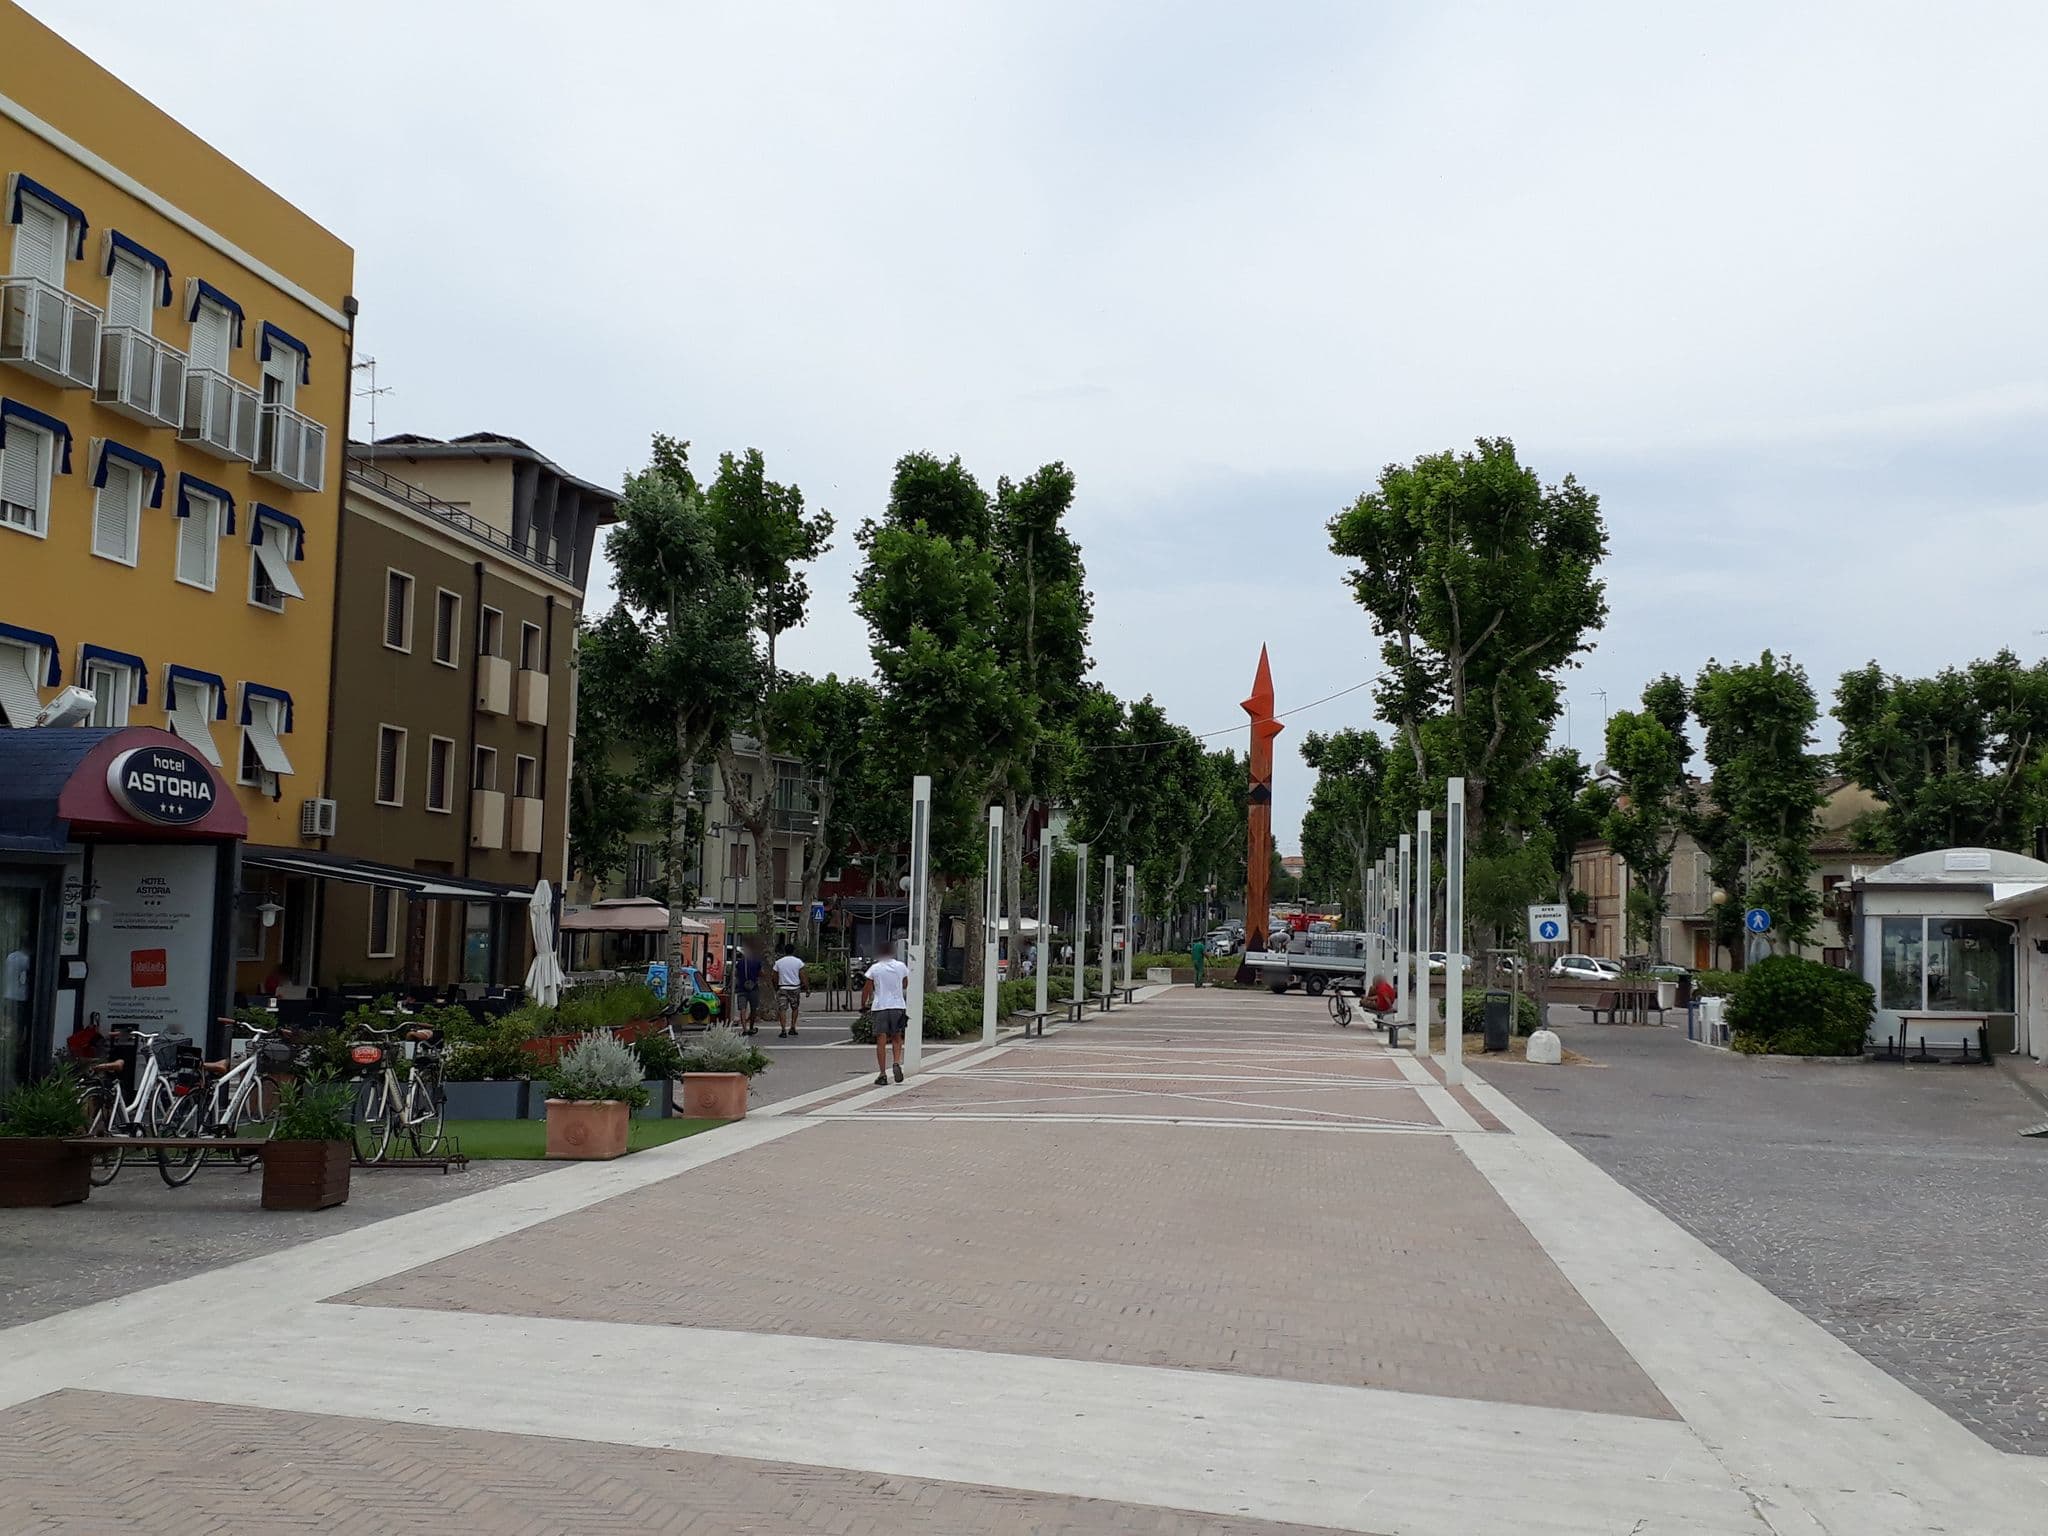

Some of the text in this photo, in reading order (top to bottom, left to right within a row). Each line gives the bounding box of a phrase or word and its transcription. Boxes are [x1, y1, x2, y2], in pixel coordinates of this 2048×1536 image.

[153, 754, 185, 773] hotel
[127, 771, 212, 801] ASTORIA
[141, 877, 167, 886] HOTEL
[136, 886, 171, 895] ASTORIA
